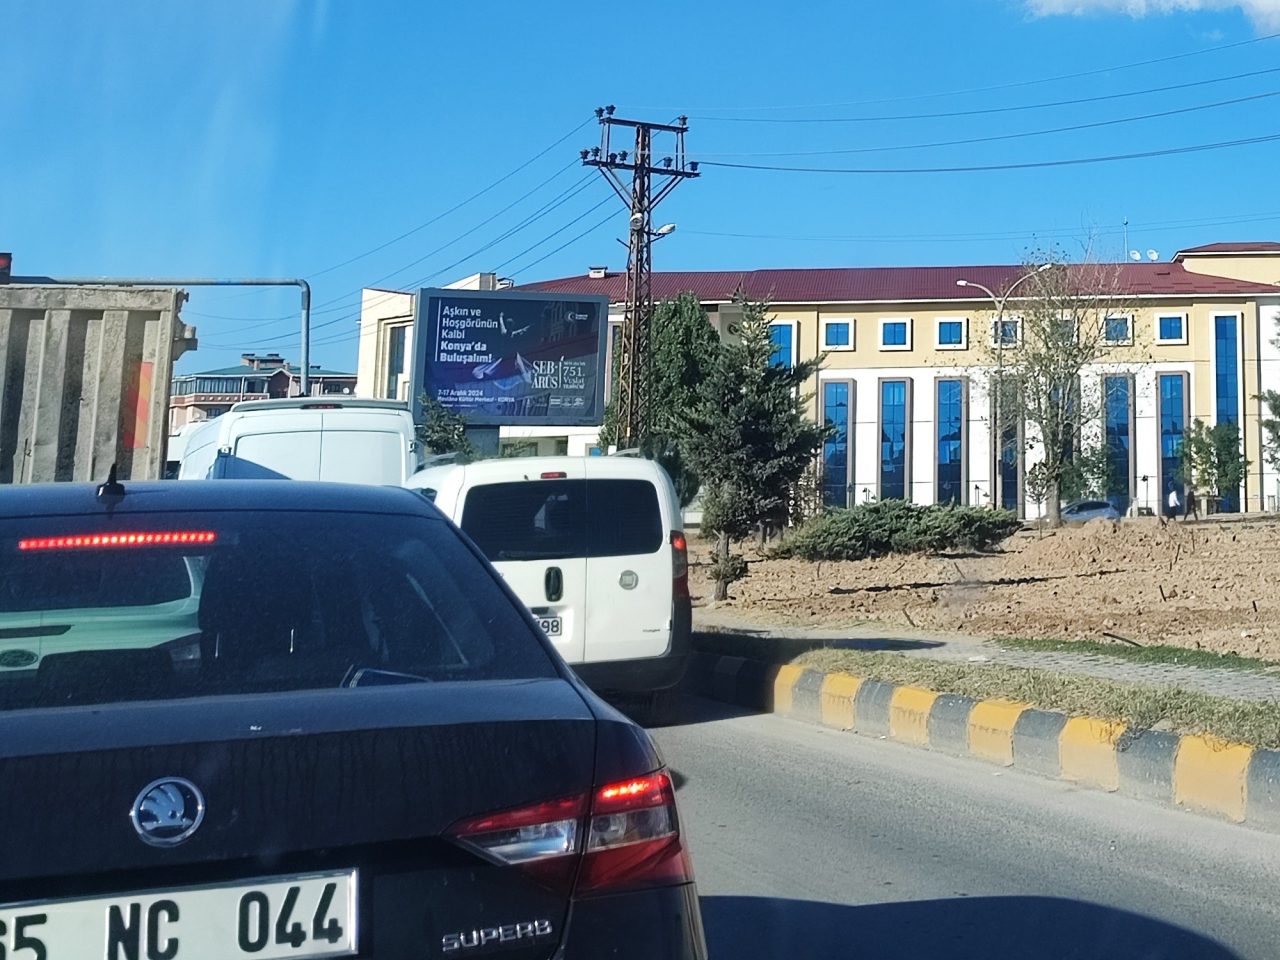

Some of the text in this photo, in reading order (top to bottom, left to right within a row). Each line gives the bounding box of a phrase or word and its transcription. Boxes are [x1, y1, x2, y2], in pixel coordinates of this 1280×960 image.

[442, 306, 482, 318] Aşkın ve
[442, 317, 498, 329] Hoşgörünün
[441, 328, 465, 339] Kalbi
[440, 352, 493, 365] Buluşalım!
[0, 882, 343, 960] 5 NC 044
[442, 919, 552, 952] SUPERB
